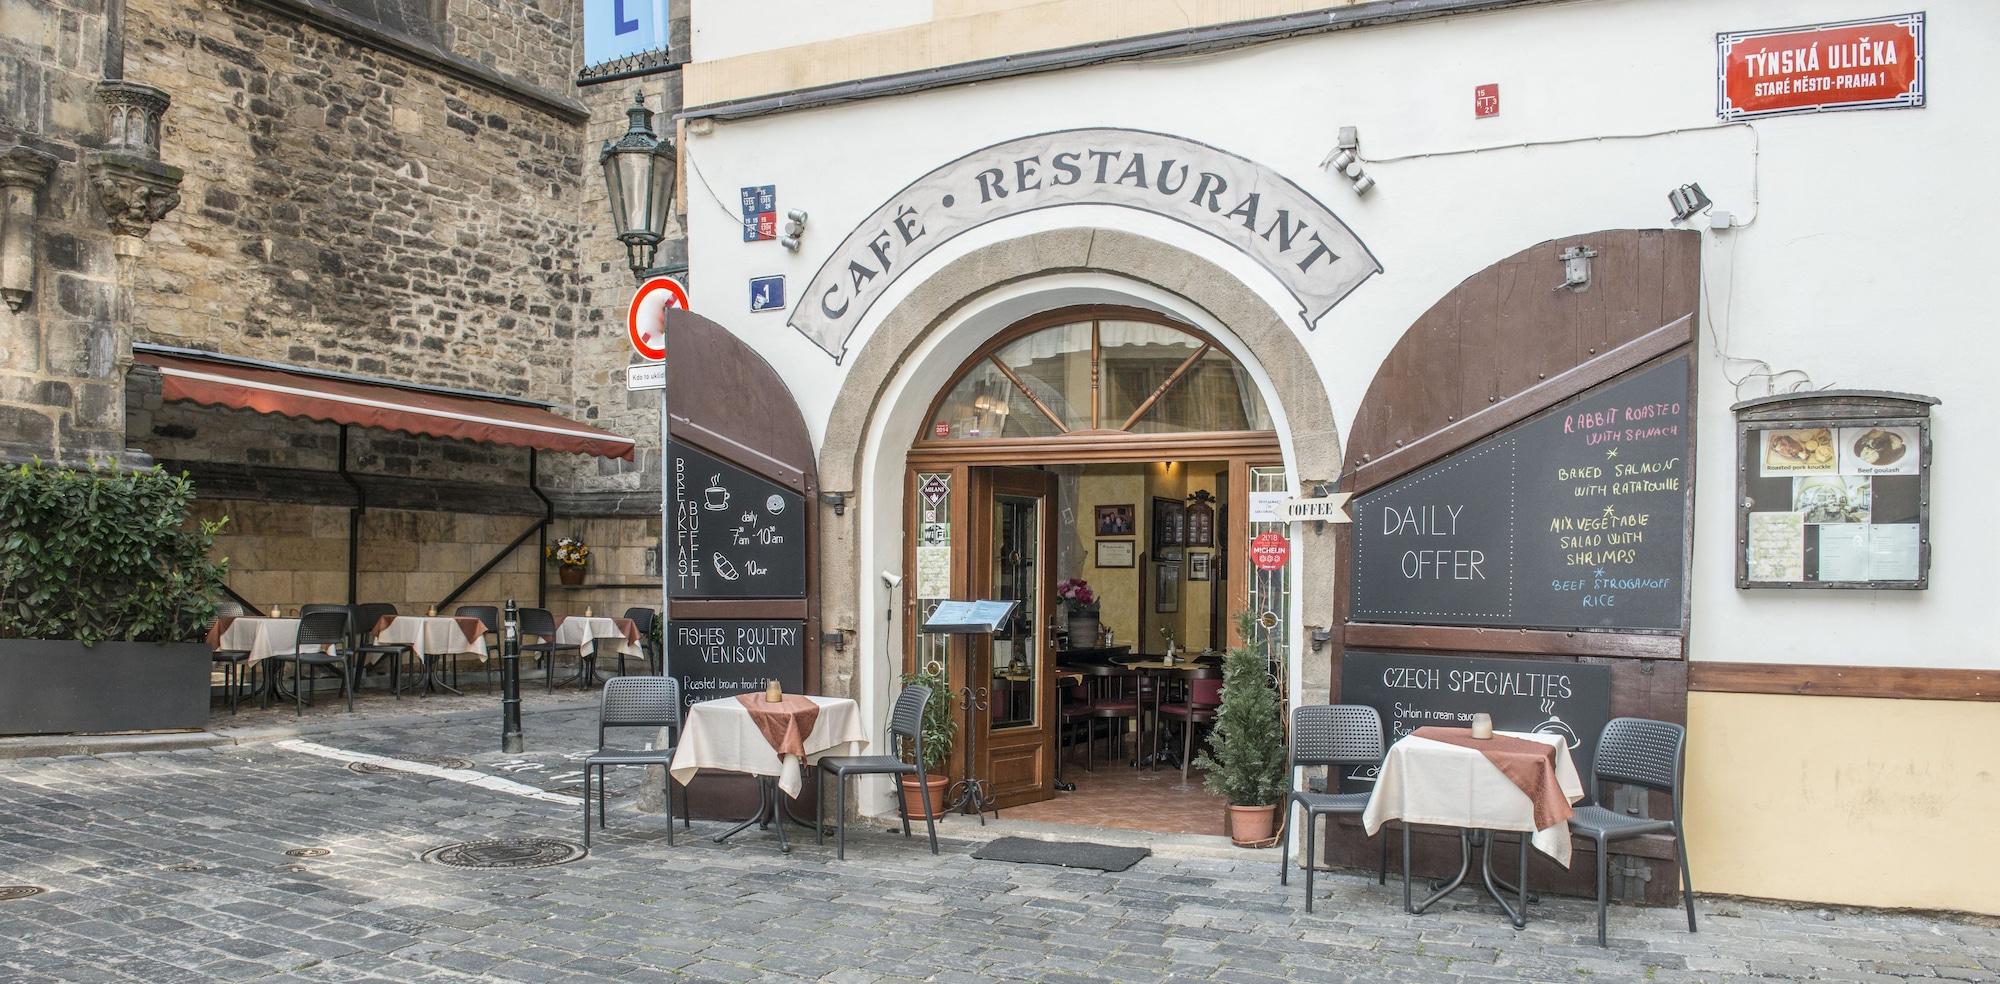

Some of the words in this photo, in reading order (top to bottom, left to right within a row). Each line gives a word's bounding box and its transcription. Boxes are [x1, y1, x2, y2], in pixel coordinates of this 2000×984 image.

[1745, 42, 1820, 78] TÝNSKÁ
[1828, 36, 1898, 69] ULIČKA
[1754, 77, 1791, 97] STARÉ
[1879, 71, 1886, 86] 1
[821, 204, 926, 320] CAFÉ
[974, 150, 1341, 275] RESTAURANT
[1564, 407, 1619, 434] RABBIT
[1625, 402, 1680, 421] ROASTED
[1586, 430, 1621, 446] WITH
[1625, 425, 1678, 442] SPINACH
[1558, 466, 1602, 481] BAKED
[1614, 457, 1680, 478] SALMON
[1874, 467, 1900, 475] goulash
[1574, 484, 1607, 497] WITH
[1288, 503, 1333, 516] COFFEE
[676, 457, 688, 590] BREAKFAST
[741, 510, 758, 528] daily
[1384, 504, 1464, 536] DAILY
[1550, 516, 1573, 533] MIX
[689, 500, 701, 590] BUFFET
[1560, 534, 1601, 549] SALAD
[1607, 532, 1643, 545] WITH
[1401, 550, 1486, 580] OFFER
[1566, 549, 1636, 566] SHRIMPS
[1551, 579, 1585, 591] BEEF
[1582, 594, 1615, 607] RICE
[678, 628, 725, 646] FISHES
[737, 628, 797, 646] POULTRY
[701, 646, 766, 663] VENISON
[684, 676, 716, 690] Roasted
[1383, 667, 1440, 690] CZECH
[1447, 670, 1572, 699] SPECIALTIES
[1393, 701, 1422, 719] Sirloin
[1424, 709, 1431, 718] in
[1433, 711, 1454, 720] cream
